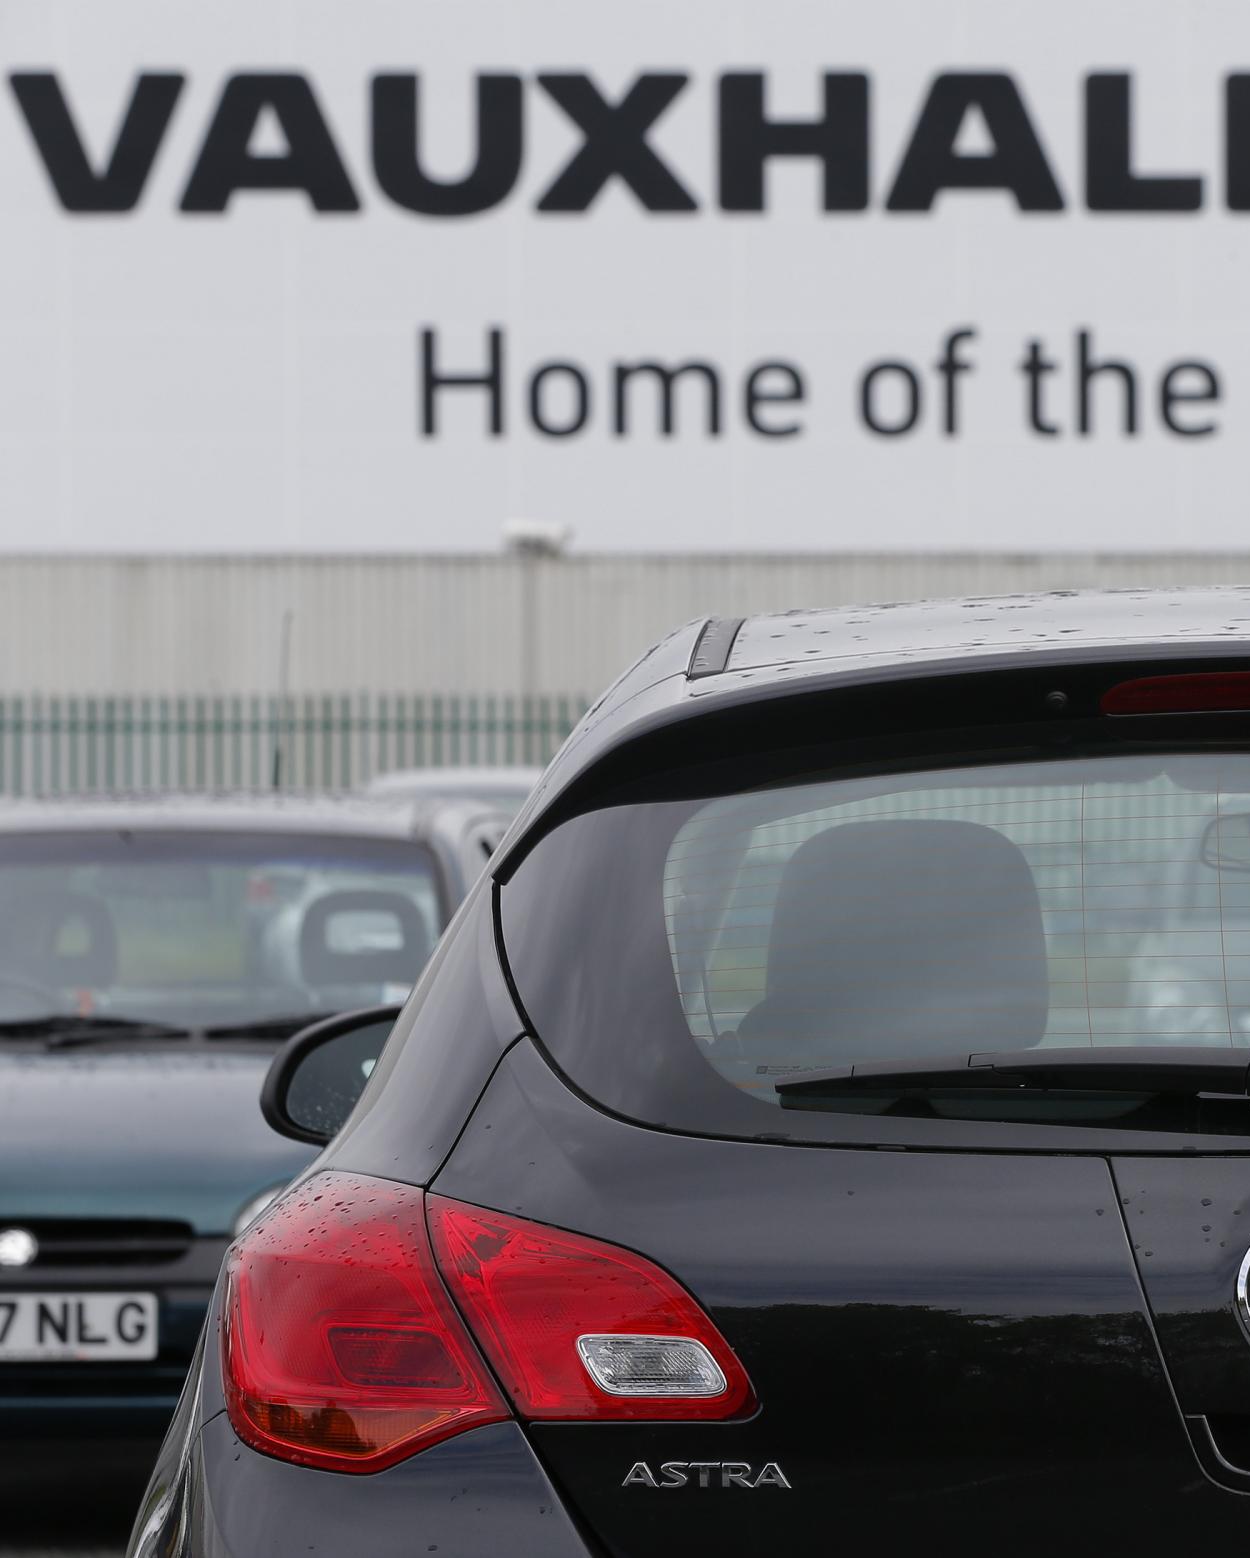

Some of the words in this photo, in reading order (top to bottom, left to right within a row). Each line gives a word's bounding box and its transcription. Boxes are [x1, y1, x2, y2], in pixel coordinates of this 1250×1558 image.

[419, 326, 807, 439] Home
[858, 327, 976, 439] of
[1019, 328, 1222, 439] the
[38, 1302, 147, 1344] NLG
[621, 1461, 792, 1489] ASTRA
